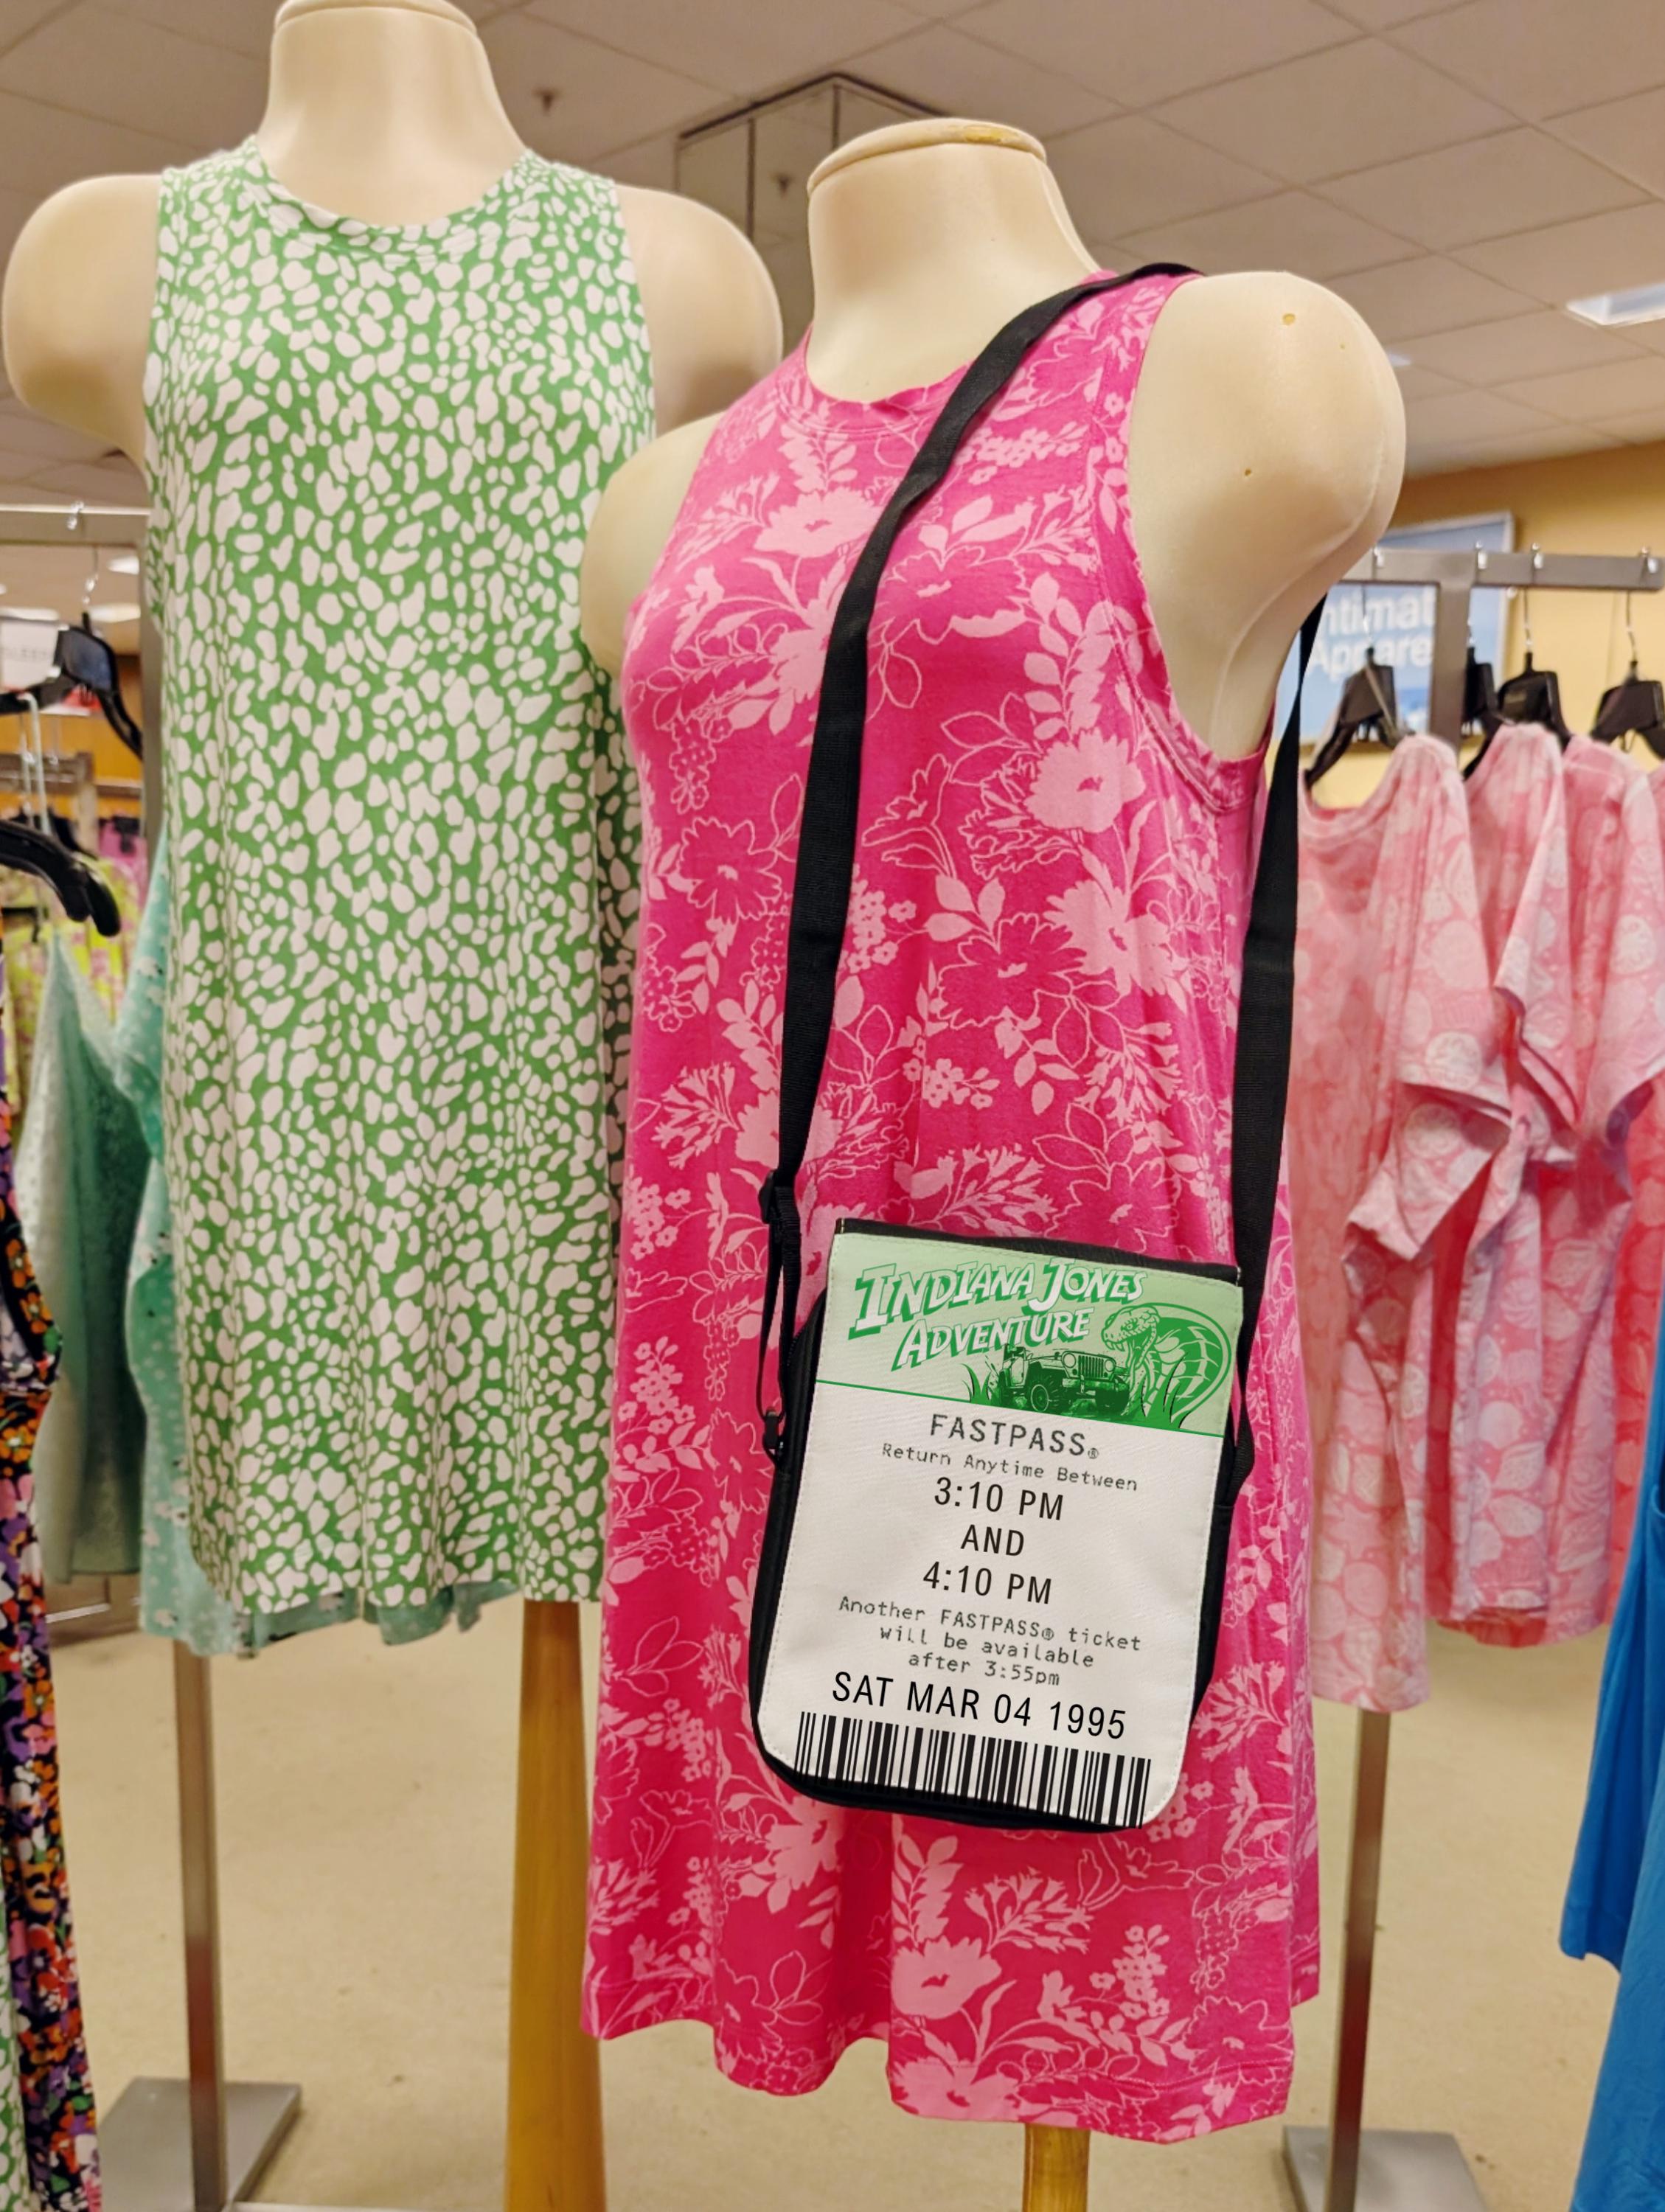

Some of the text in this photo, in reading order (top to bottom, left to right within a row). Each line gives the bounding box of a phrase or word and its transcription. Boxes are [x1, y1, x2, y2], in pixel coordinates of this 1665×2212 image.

[1320, 588, 1435, 635] ntimat
[1307, 636, 1433, 682] Appare
[849, 1259, 1148, 1340] INDIANA JONES
[891, 1307, 1095, 1371] ADVENTURE
[883, 1443, 1137, 1491] Return Anytime Between
[934, 1477, 1063, 1520] 3:10 PM
[960, 1524, 1024, 1557] AND
[923, 1561, 1052, 1604] 4:10 PM
[839, 1596, 925, 1621] Another
[1068, 1627, 1140, 1651] ticket
[880, 1626, 1094, 1668] will be available
[908, 1652, 1060, 1686] after 3:55pm
[832, 1672, 1126, 1739] SAT MAR 04 1995
